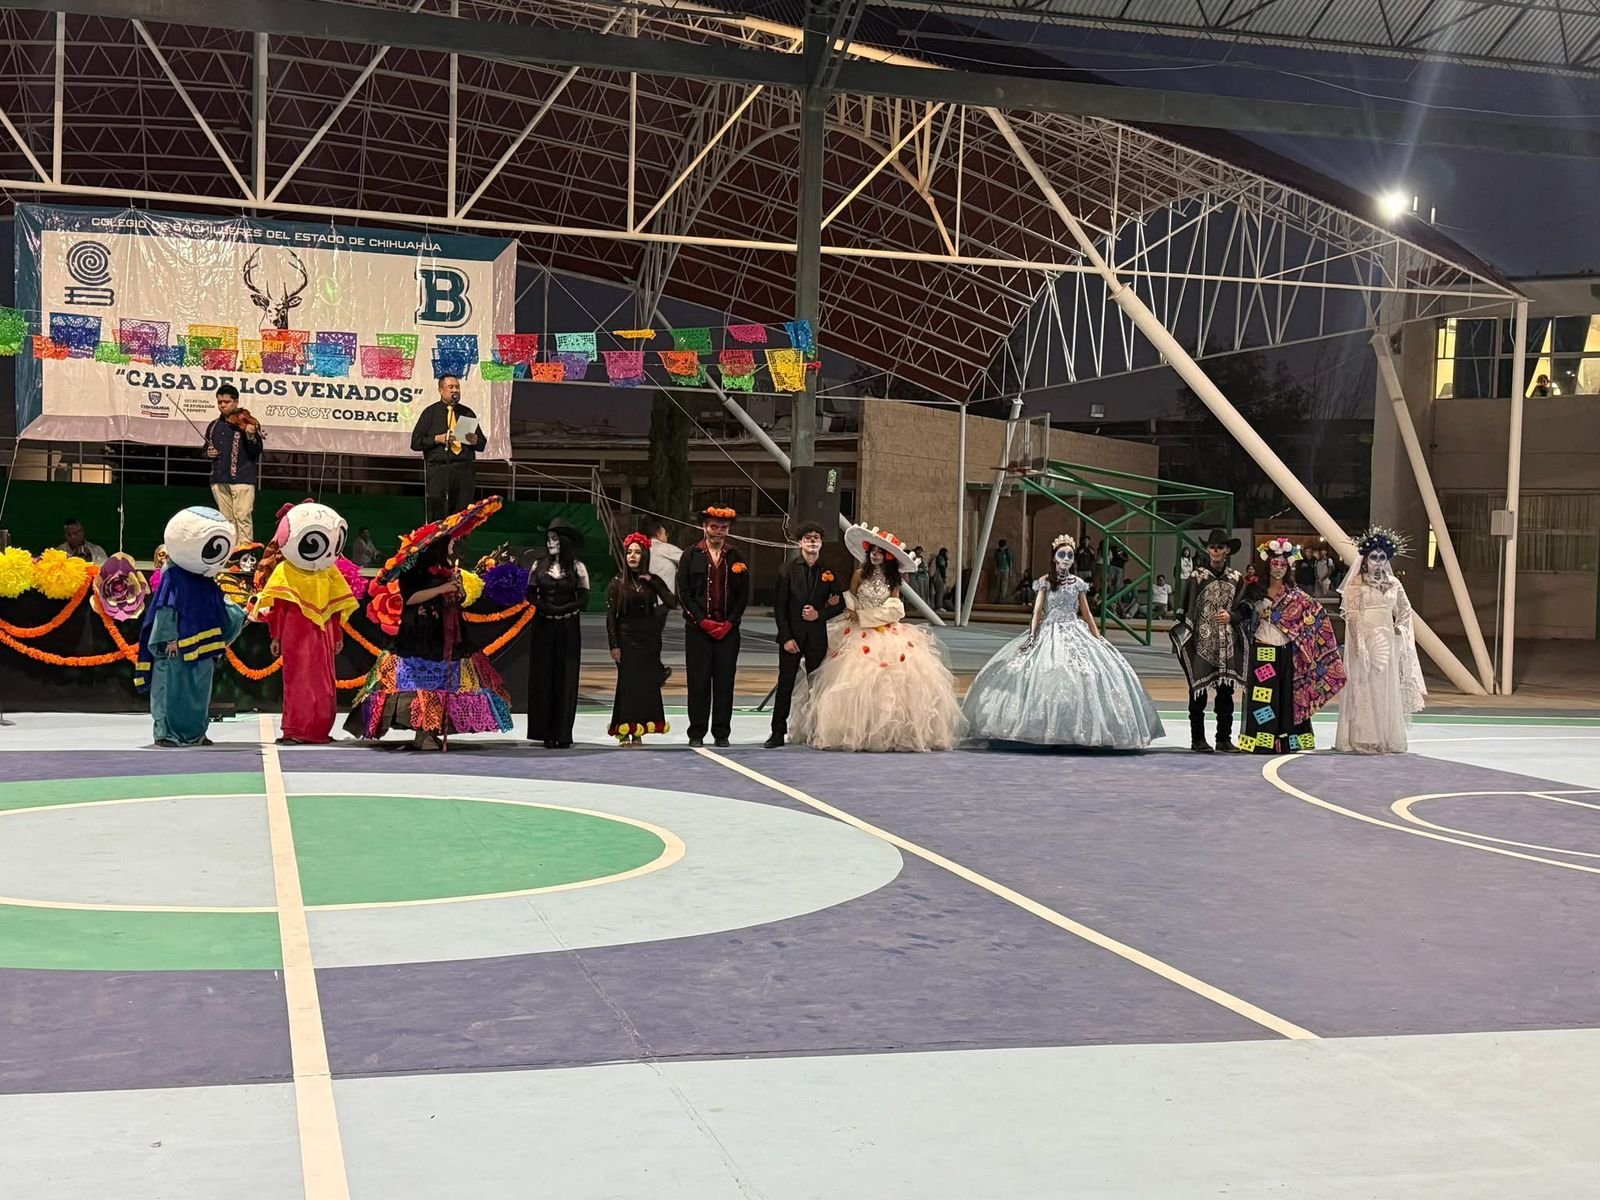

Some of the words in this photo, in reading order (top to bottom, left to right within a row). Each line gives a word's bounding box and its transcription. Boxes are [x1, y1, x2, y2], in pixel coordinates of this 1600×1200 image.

[91, 217, 147, 229] COLEGIO
[174, 223, 262, 238] BACHILLERES
[266, 229, 291, 240] DEL
[294, 232, 345, 245] ESTADO
[349, 236, 366, 246] DE
[369, 239, 442, 252] CHIHUAHUA
[239, 377, 288, 397] LOS
